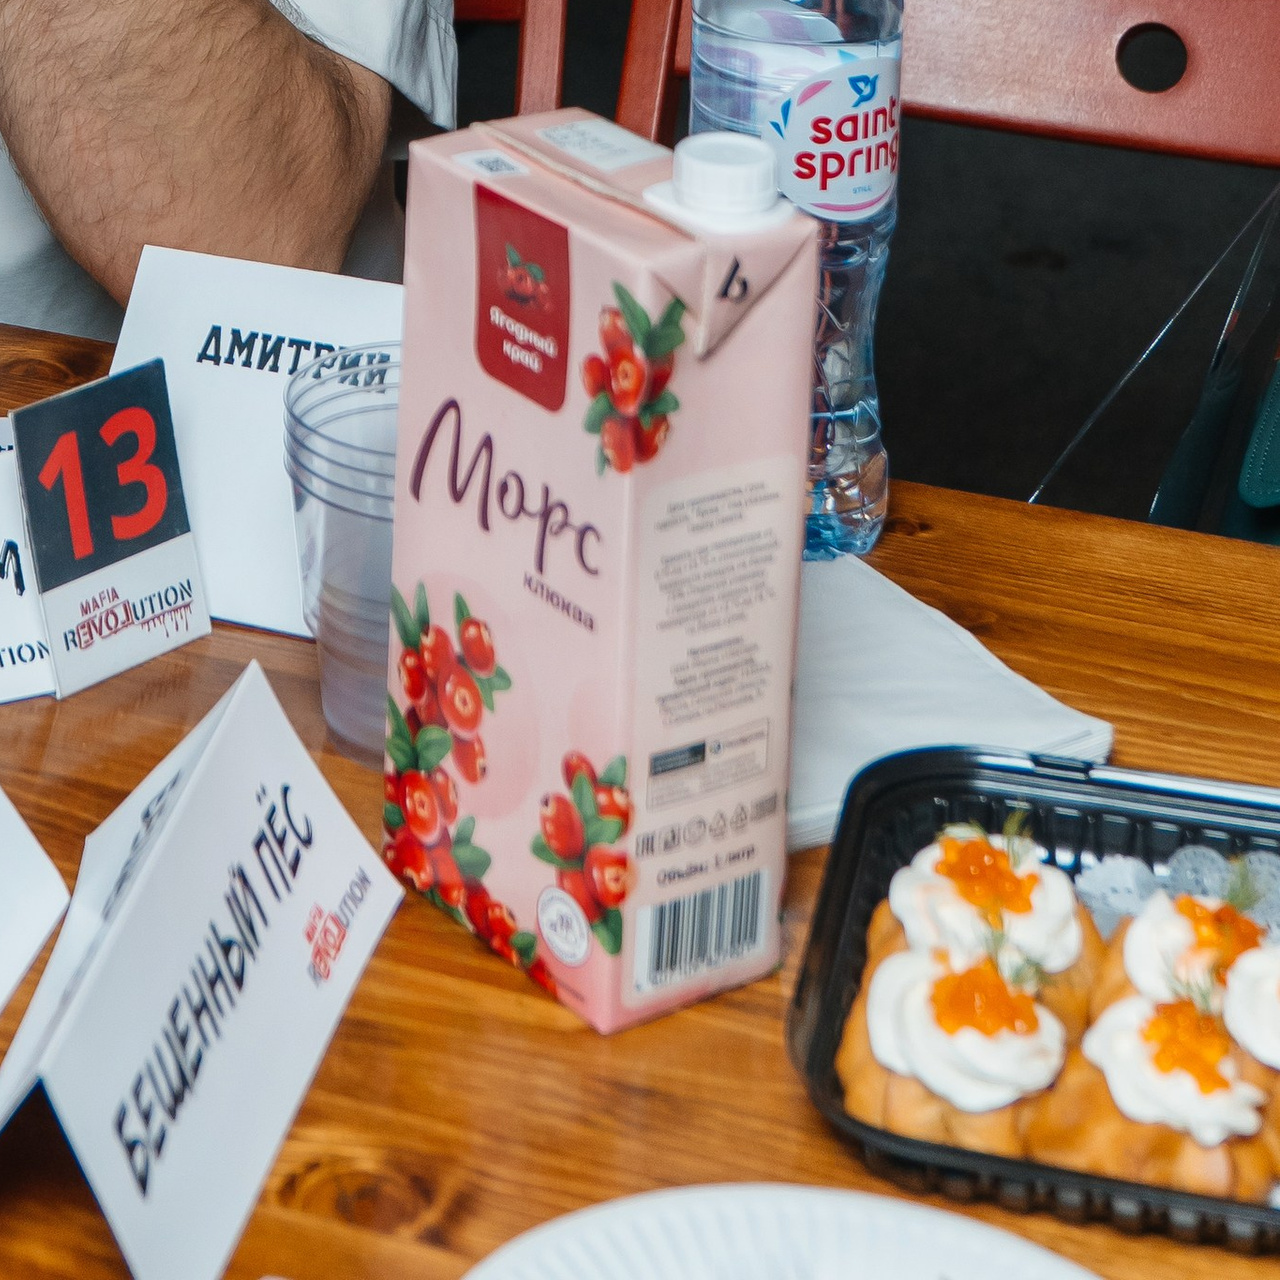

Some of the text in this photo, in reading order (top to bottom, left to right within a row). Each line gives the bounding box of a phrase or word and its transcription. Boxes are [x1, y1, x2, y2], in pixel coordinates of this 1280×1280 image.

[810, 95, 897, 145] saint
[792, 130, 901, 192] spring
[489, 305, 558, 359] Ягодный
[502, 338, 543, 374] край
[37, 405, 168, 561] 13
[408, 395, 601, 576] Морс
[62, 578, 194, 652] REVOLUTION
[79, 585, 120, 618] MAFIA
[522, 571, 596, 632] клюква
[112, 860, 270, 1199] БЕШЕННЫЙ
[251, 780, 315, 904] ПЁС
